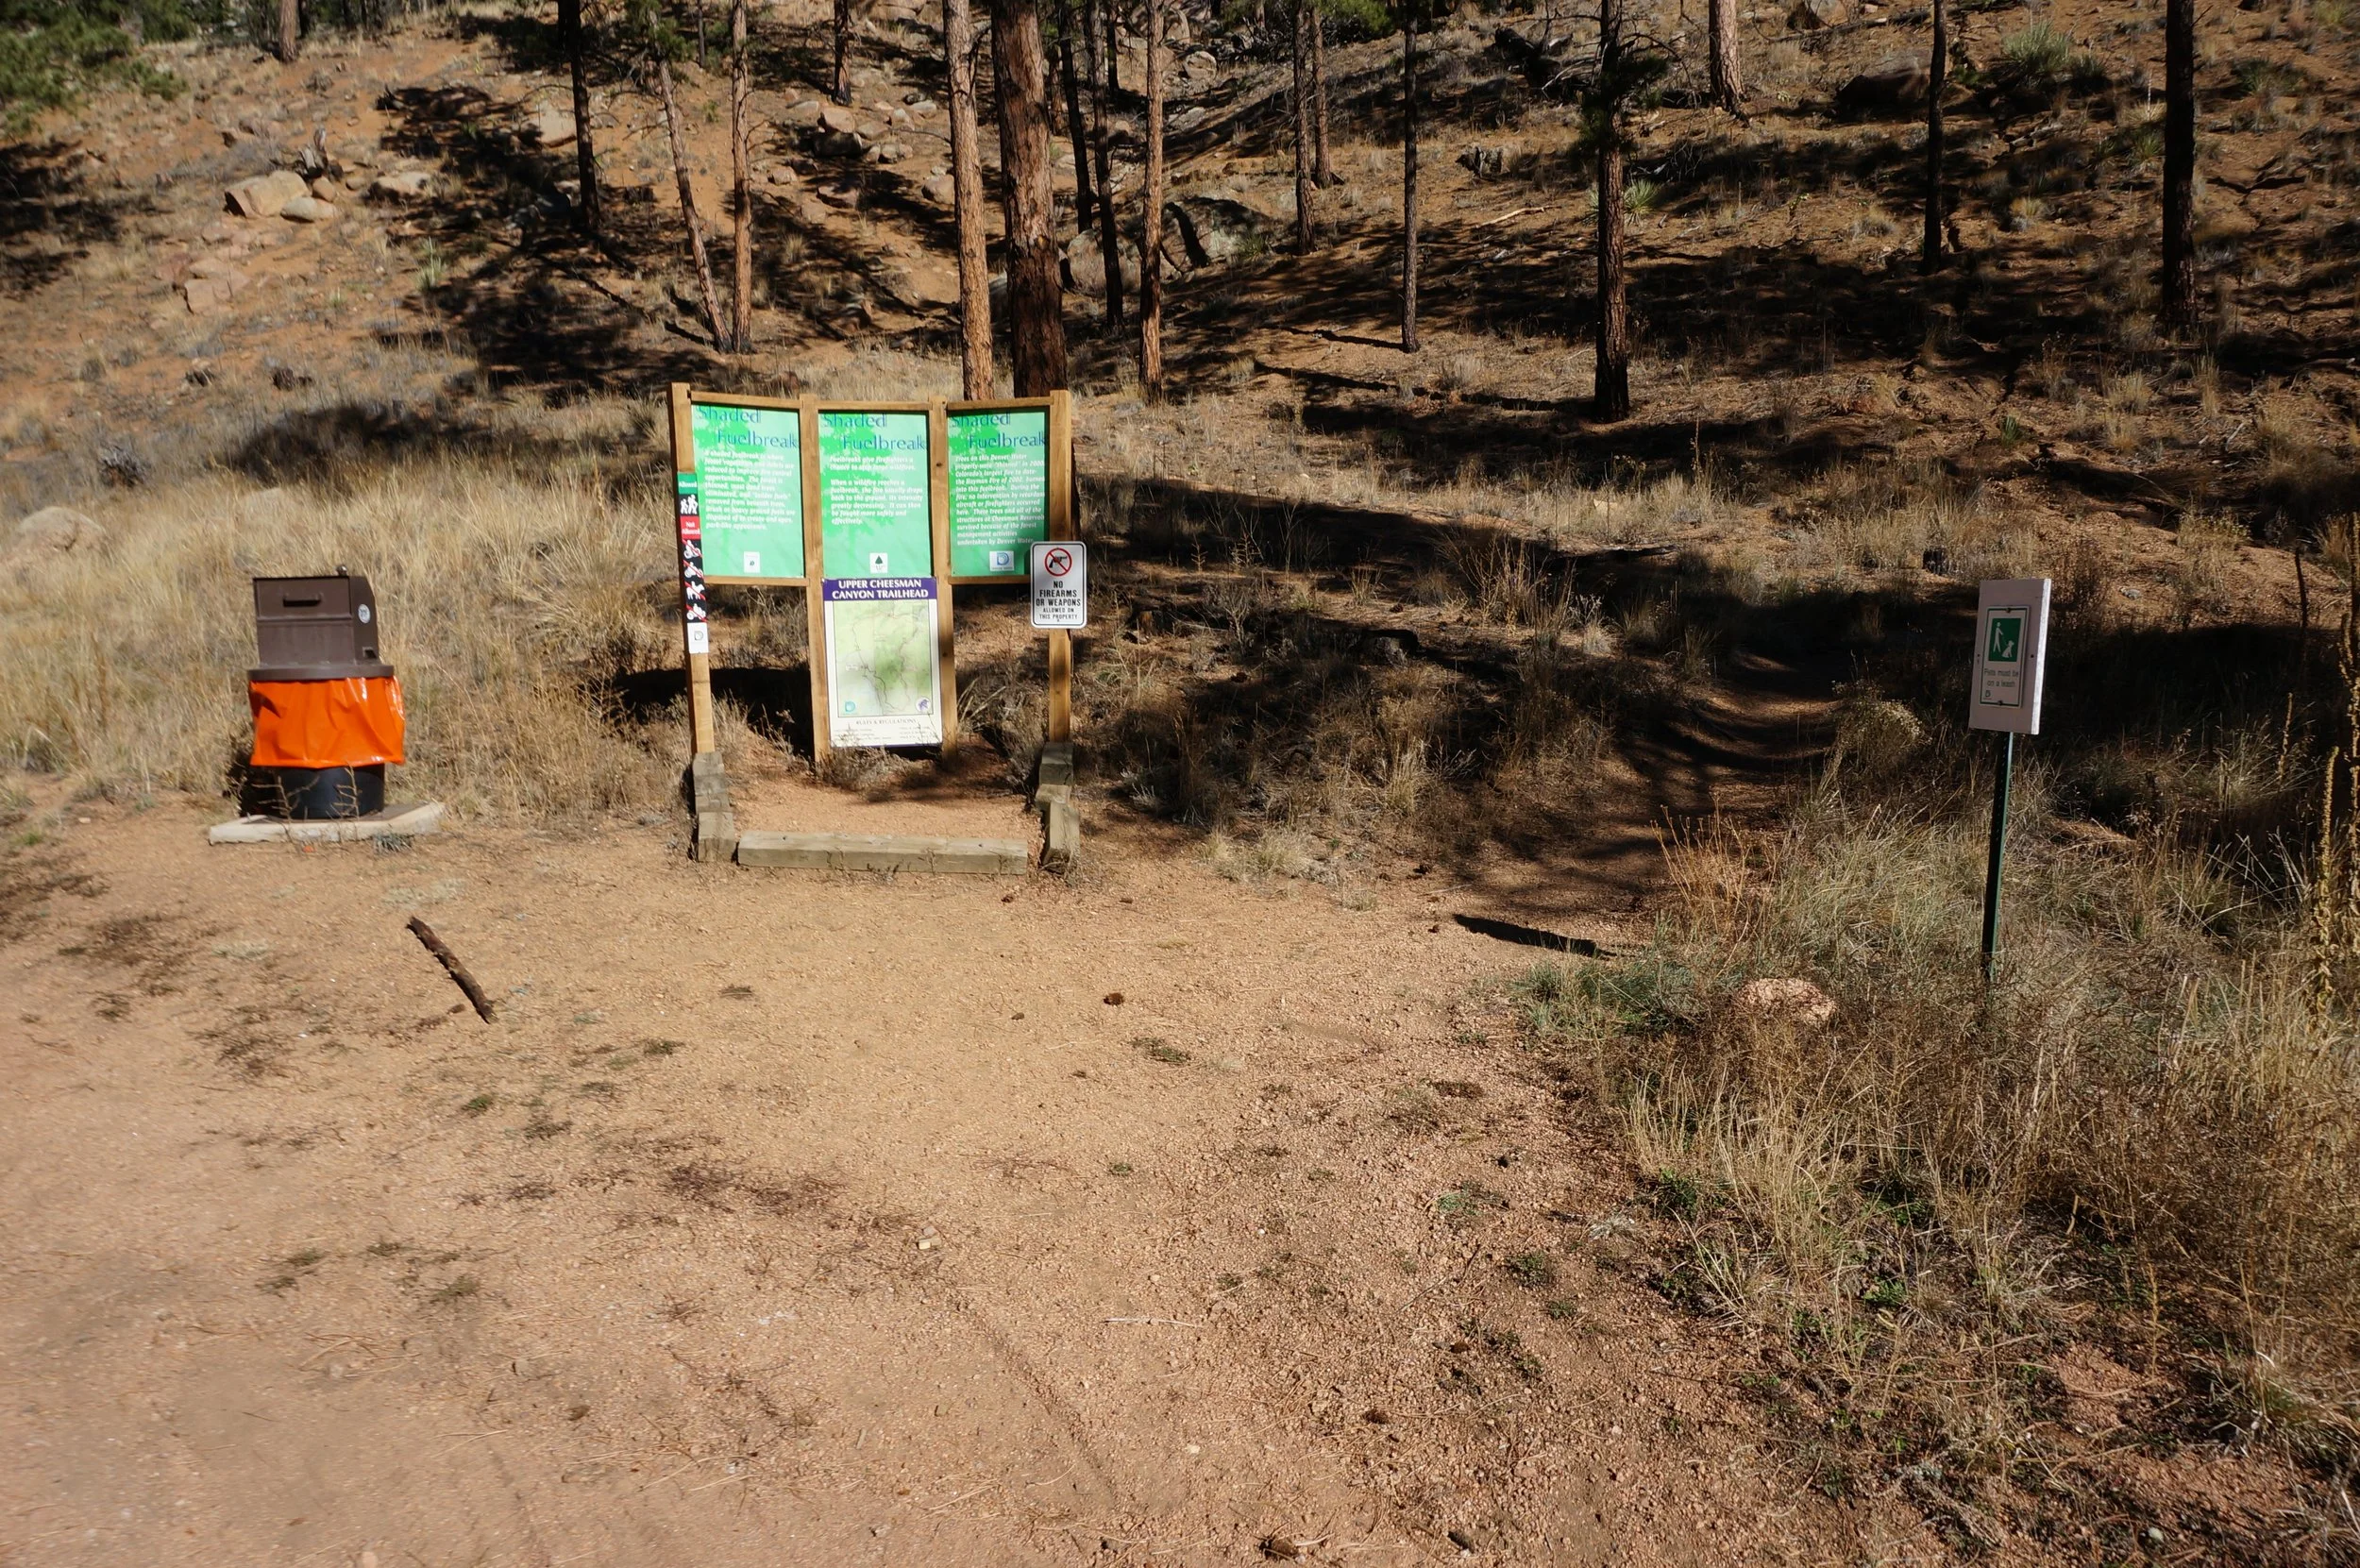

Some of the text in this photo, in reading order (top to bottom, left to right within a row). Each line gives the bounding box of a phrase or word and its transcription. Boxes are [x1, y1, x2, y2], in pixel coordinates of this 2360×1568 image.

[696, 406, 762, 423] Shaded
[822, 413, 887, 428] Shaded
[717, 430, 799, 448] Fuelbreak
[843, 434, 927, 449] Fuelbreak
[969, 431, 1046, 448] Fuelbreak
[838, 579, 921, 589] UPPER CHEESMAN
[832, 589, 929, 599] CANYON TRAILHEAD
[1039, 589, 1077, 598] FIREARMS
